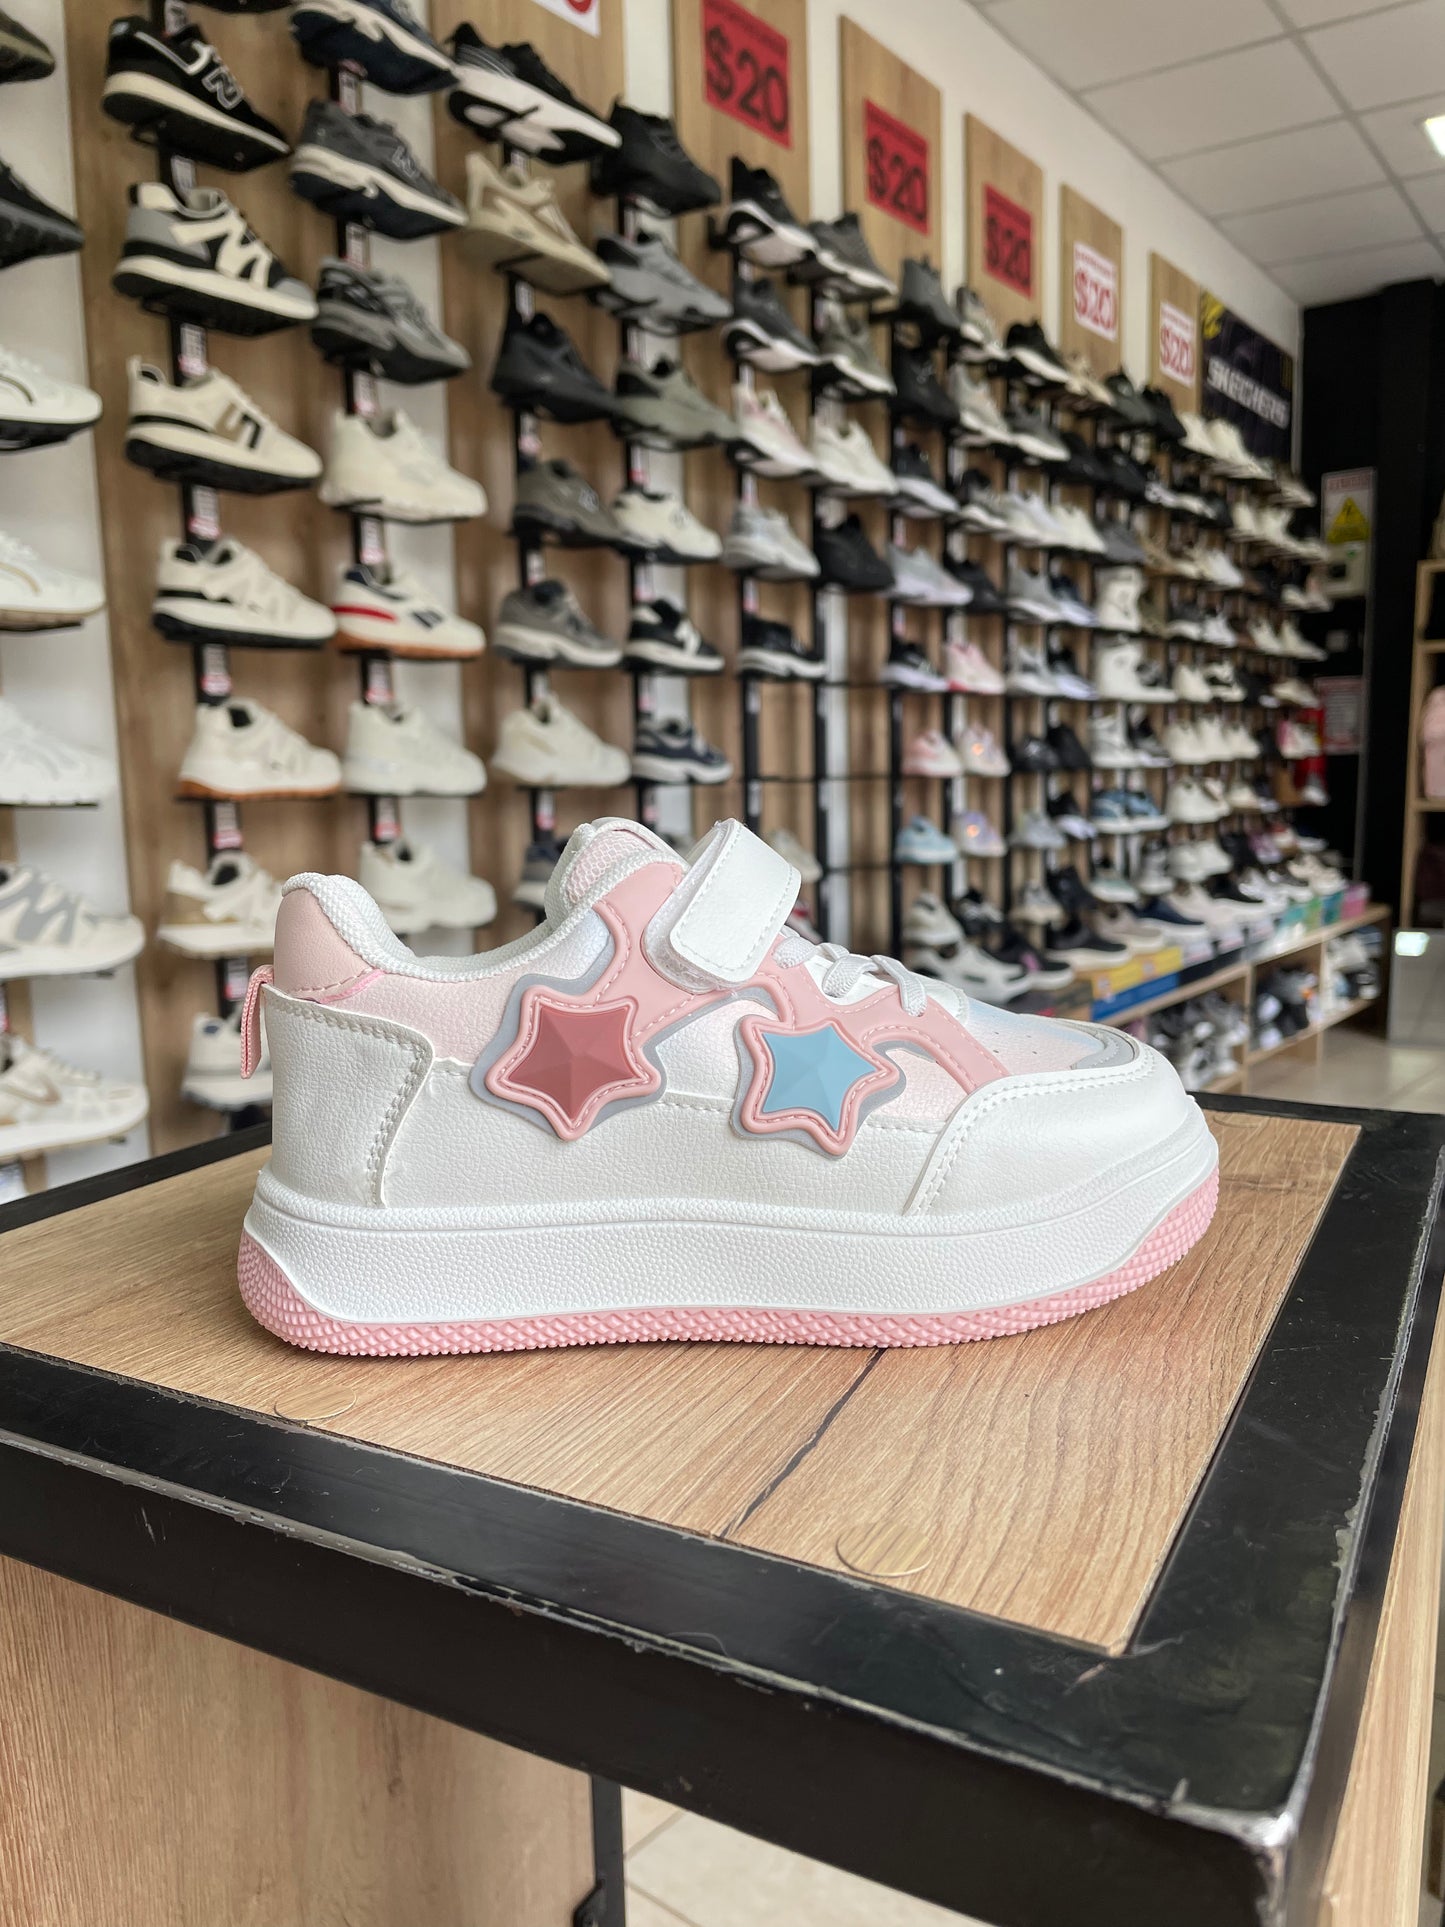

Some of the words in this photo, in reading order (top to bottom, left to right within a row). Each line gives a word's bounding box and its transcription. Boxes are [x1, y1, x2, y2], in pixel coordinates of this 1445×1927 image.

[705, 25, 788, 132] $20
[868, 137, 928, 222] $20
[986, 215, 1031, 287] $20
[1074, 269, 1117, 331] $20
[1206, 355, 1290, 430] SKECHERS
